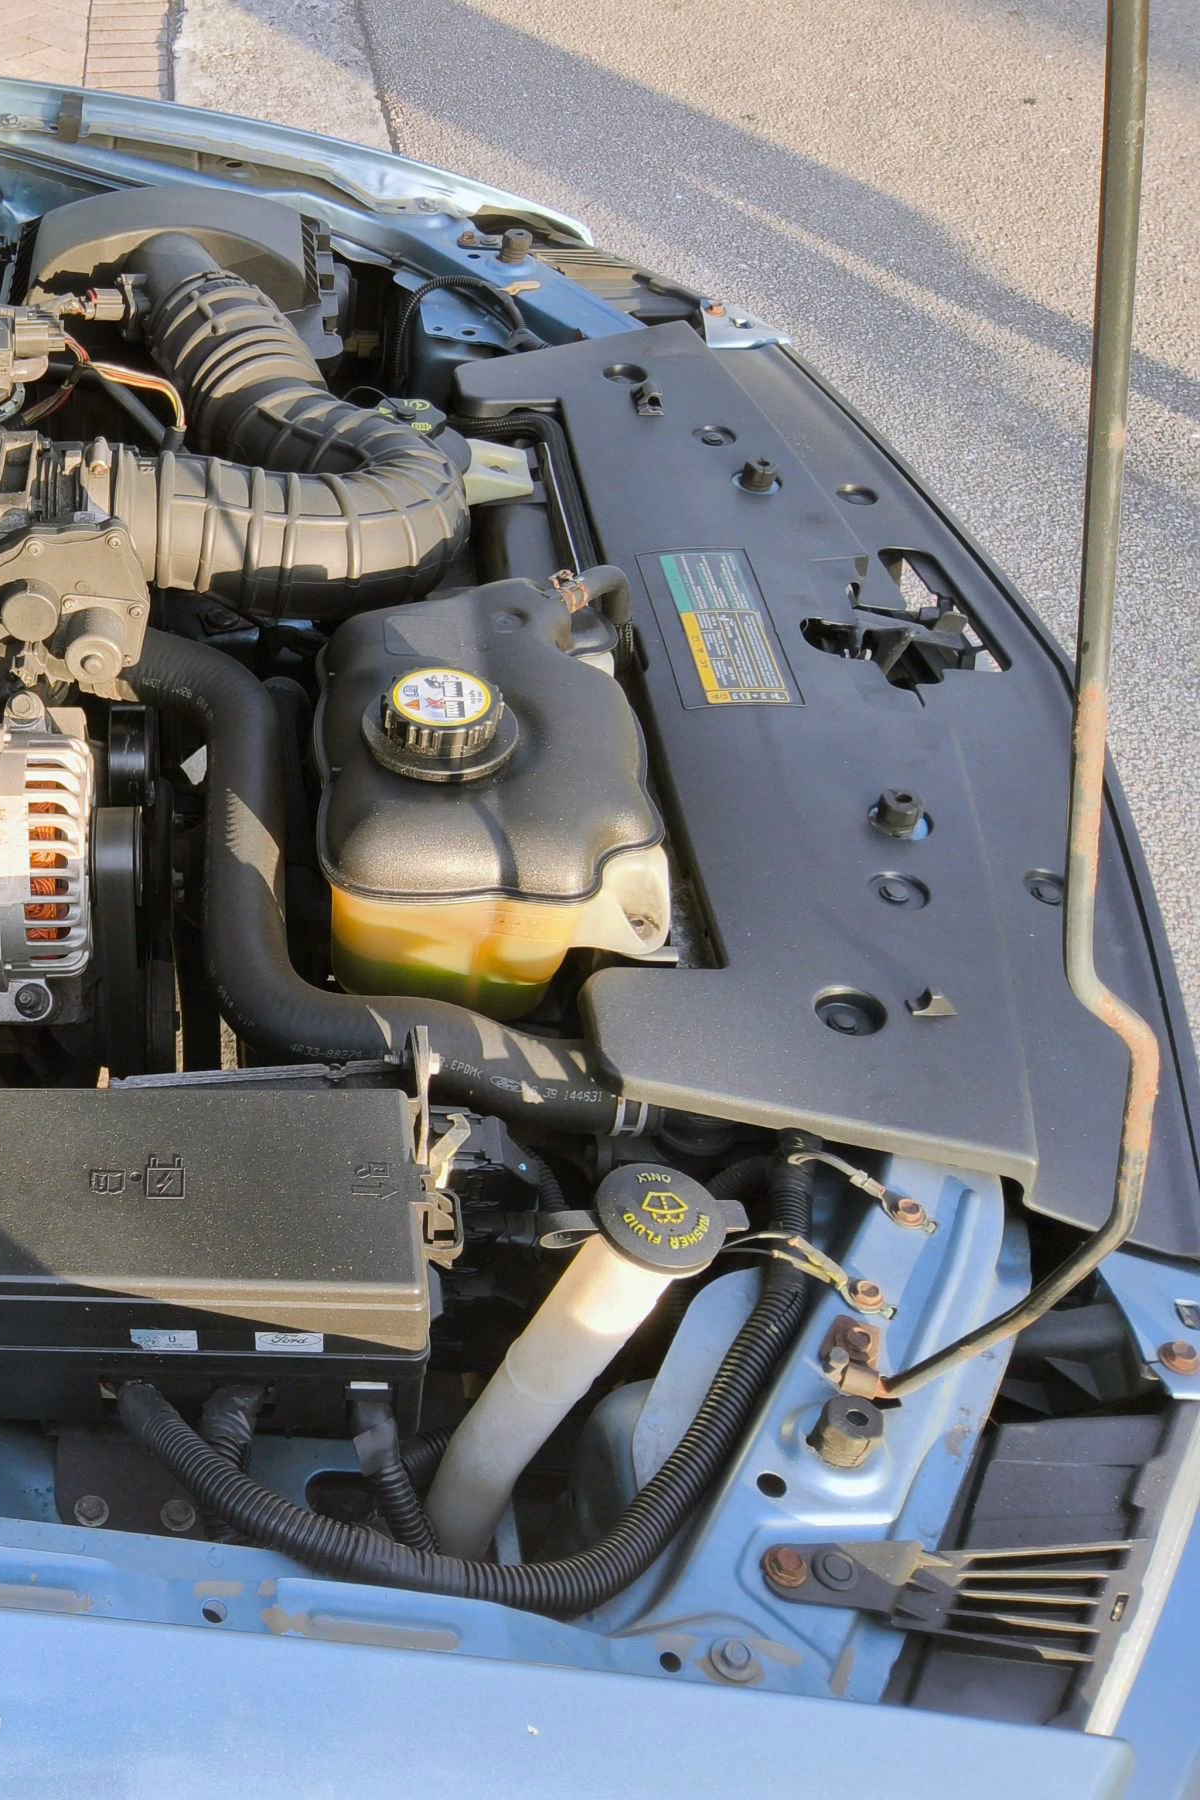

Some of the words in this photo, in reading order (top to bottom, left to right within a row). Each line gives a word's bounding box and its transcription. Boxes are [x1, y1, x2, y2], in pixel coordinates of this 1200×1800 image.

[636, 1172, 672, 1183] ONLY
[623, 1212, 662, 1245] FLUID
[669, 1214, 710, 1250] WASHER
[270, 1334, 308, 1345] Ford
